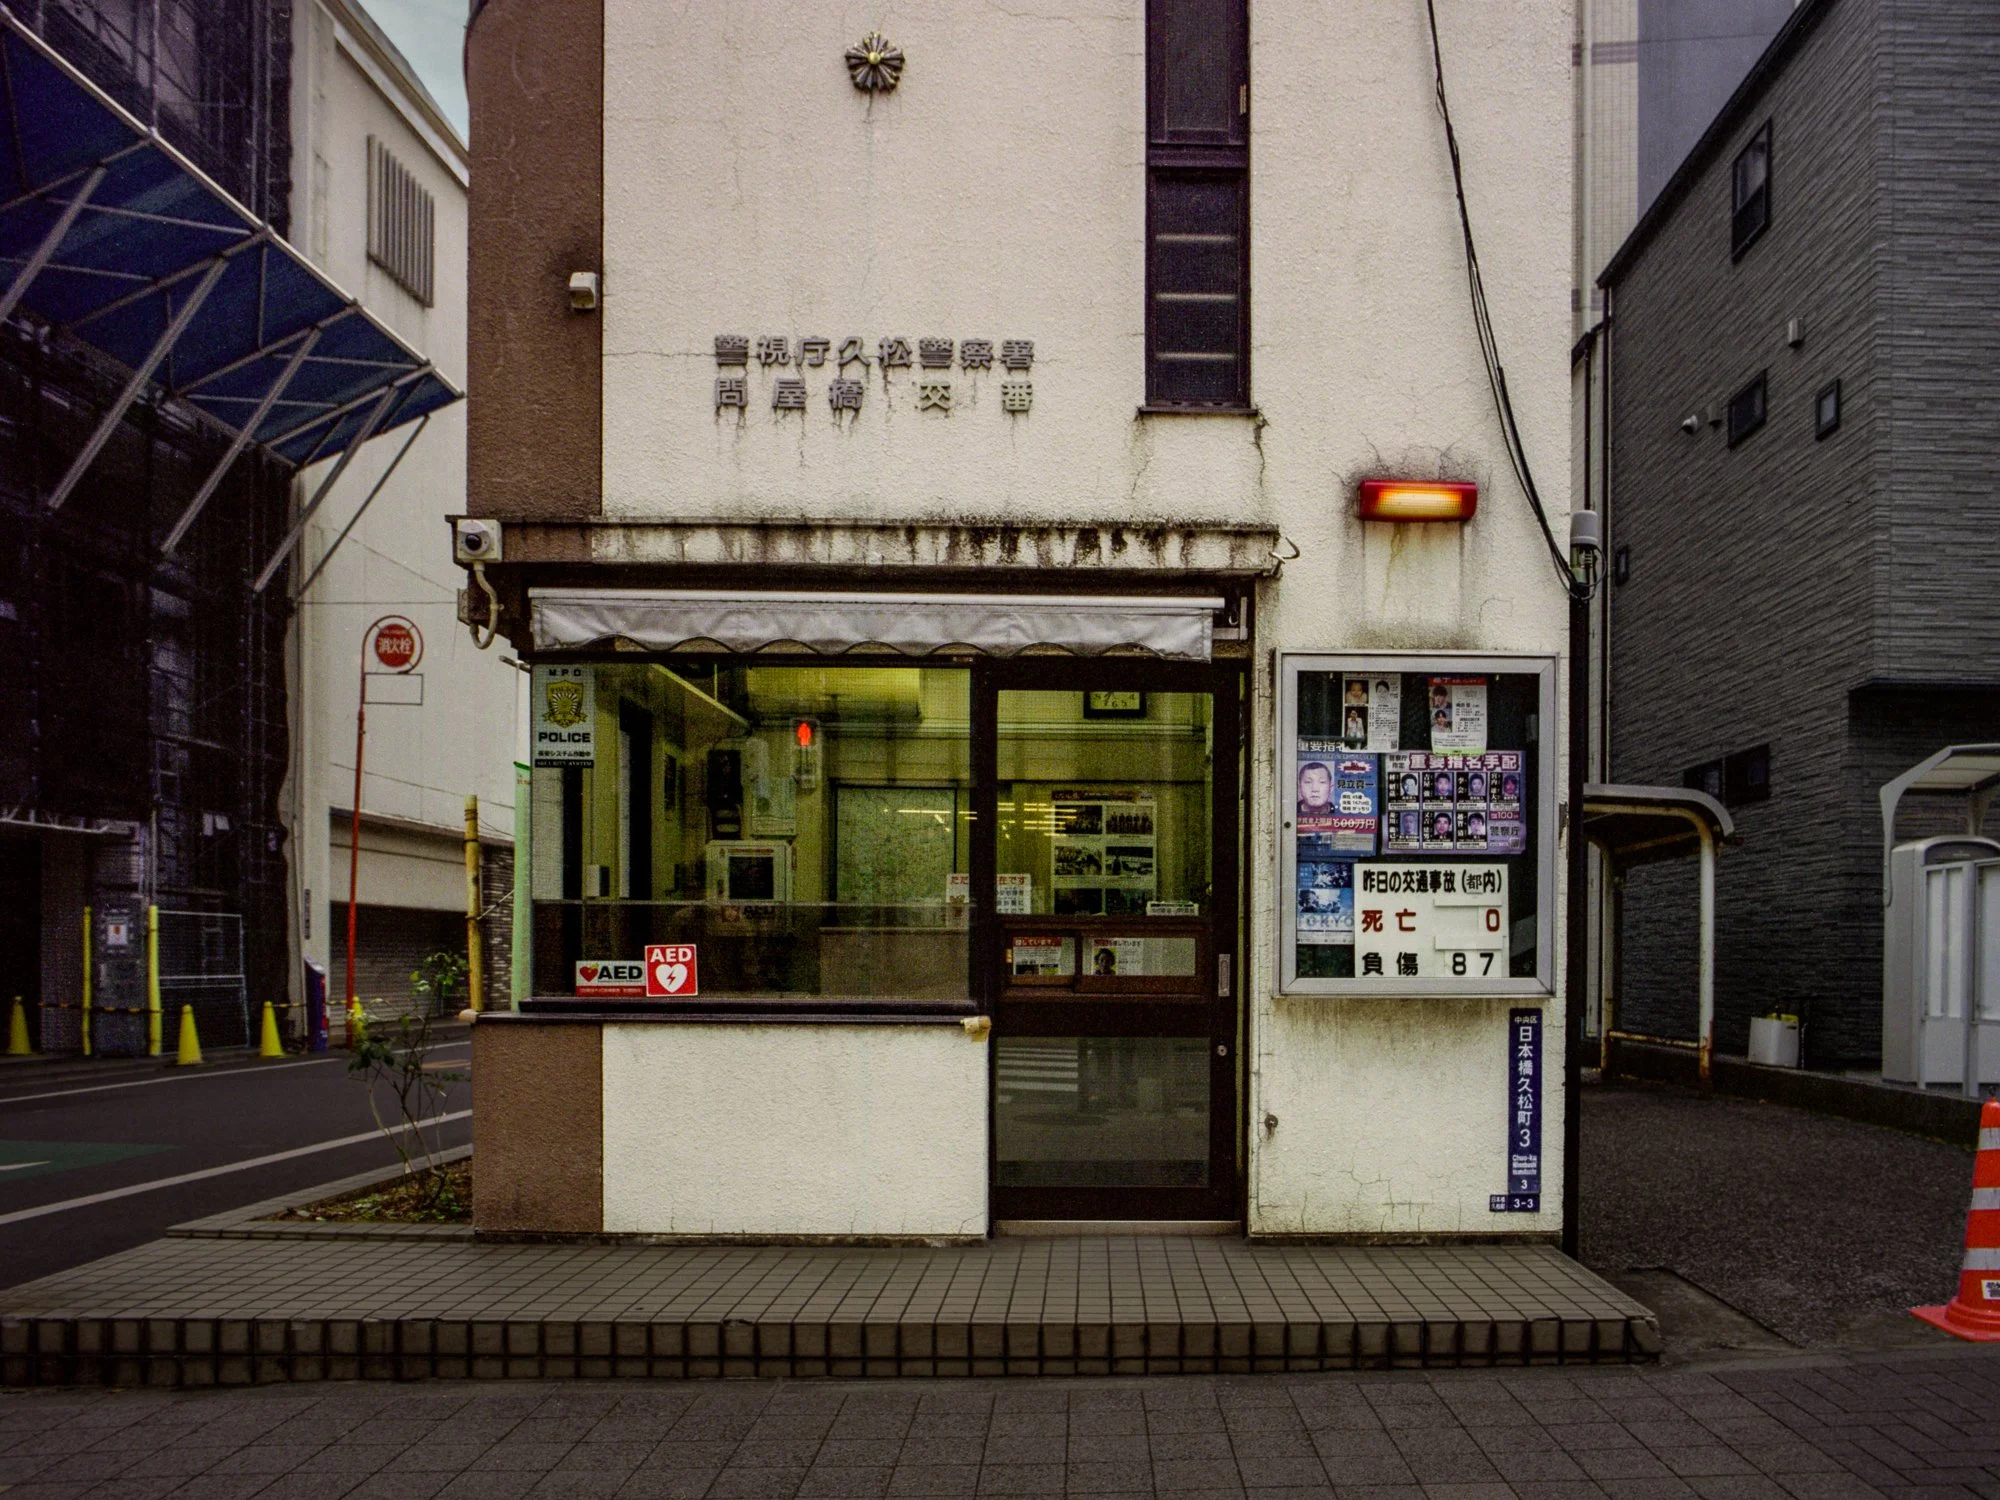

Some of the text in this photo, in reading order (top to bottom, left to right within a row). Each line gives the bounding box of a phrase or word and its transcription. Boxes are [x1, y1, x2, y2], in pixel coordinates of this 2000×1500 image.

[714, 335, 1034, 369] 警視庁久松警察署
[378, 637, 411, 654] 消火栓
[538, 732, 591, 743] POLICE
[1410, 754, 1518, 770] 重要指名手配
[1361, 908, 1500, 933] 死亡 0
[650, 947, 692, 963] AED
[1361, 952, 1494, 976] 負傷 87
[598, 965, 643, 980] AED
[1514, 1016, 1538, 1025] 中央区
[1520, 1179, 1528, 1190] 3
[1513, 1198, 1534, 1209] 3-3
